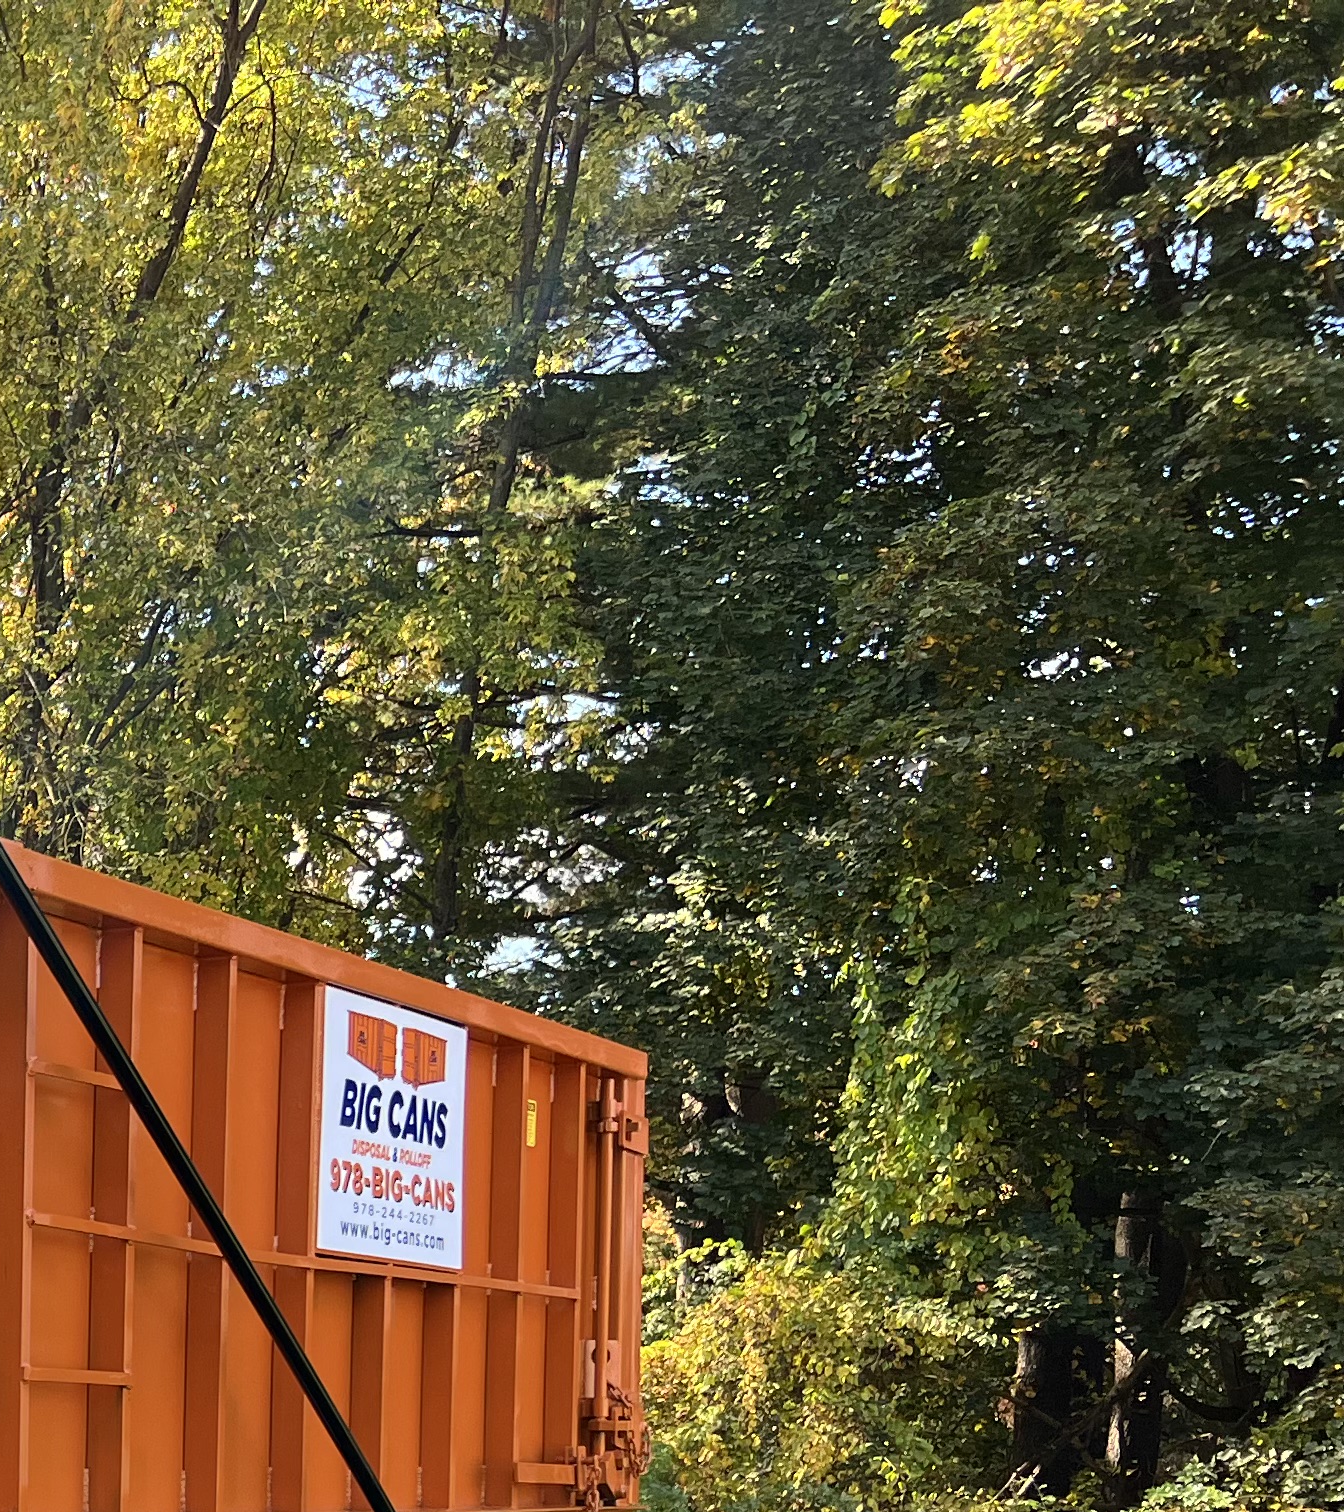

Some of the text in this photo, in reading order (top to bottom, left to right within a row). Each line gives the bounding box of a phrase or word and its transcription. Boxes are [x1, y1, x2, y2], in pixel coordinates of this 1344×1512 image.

[339, 1078, 449, 1149] BIG CANS
[351, 1138, 432, 1169] DISPOSAL & ROLLOFF
[329, 1158, 456, 1213] 978-BIG-CANS
[353, 1202, 435, 1227] 978-244-2267
[340, 1220, 445, 1251] www.big-cans.com
